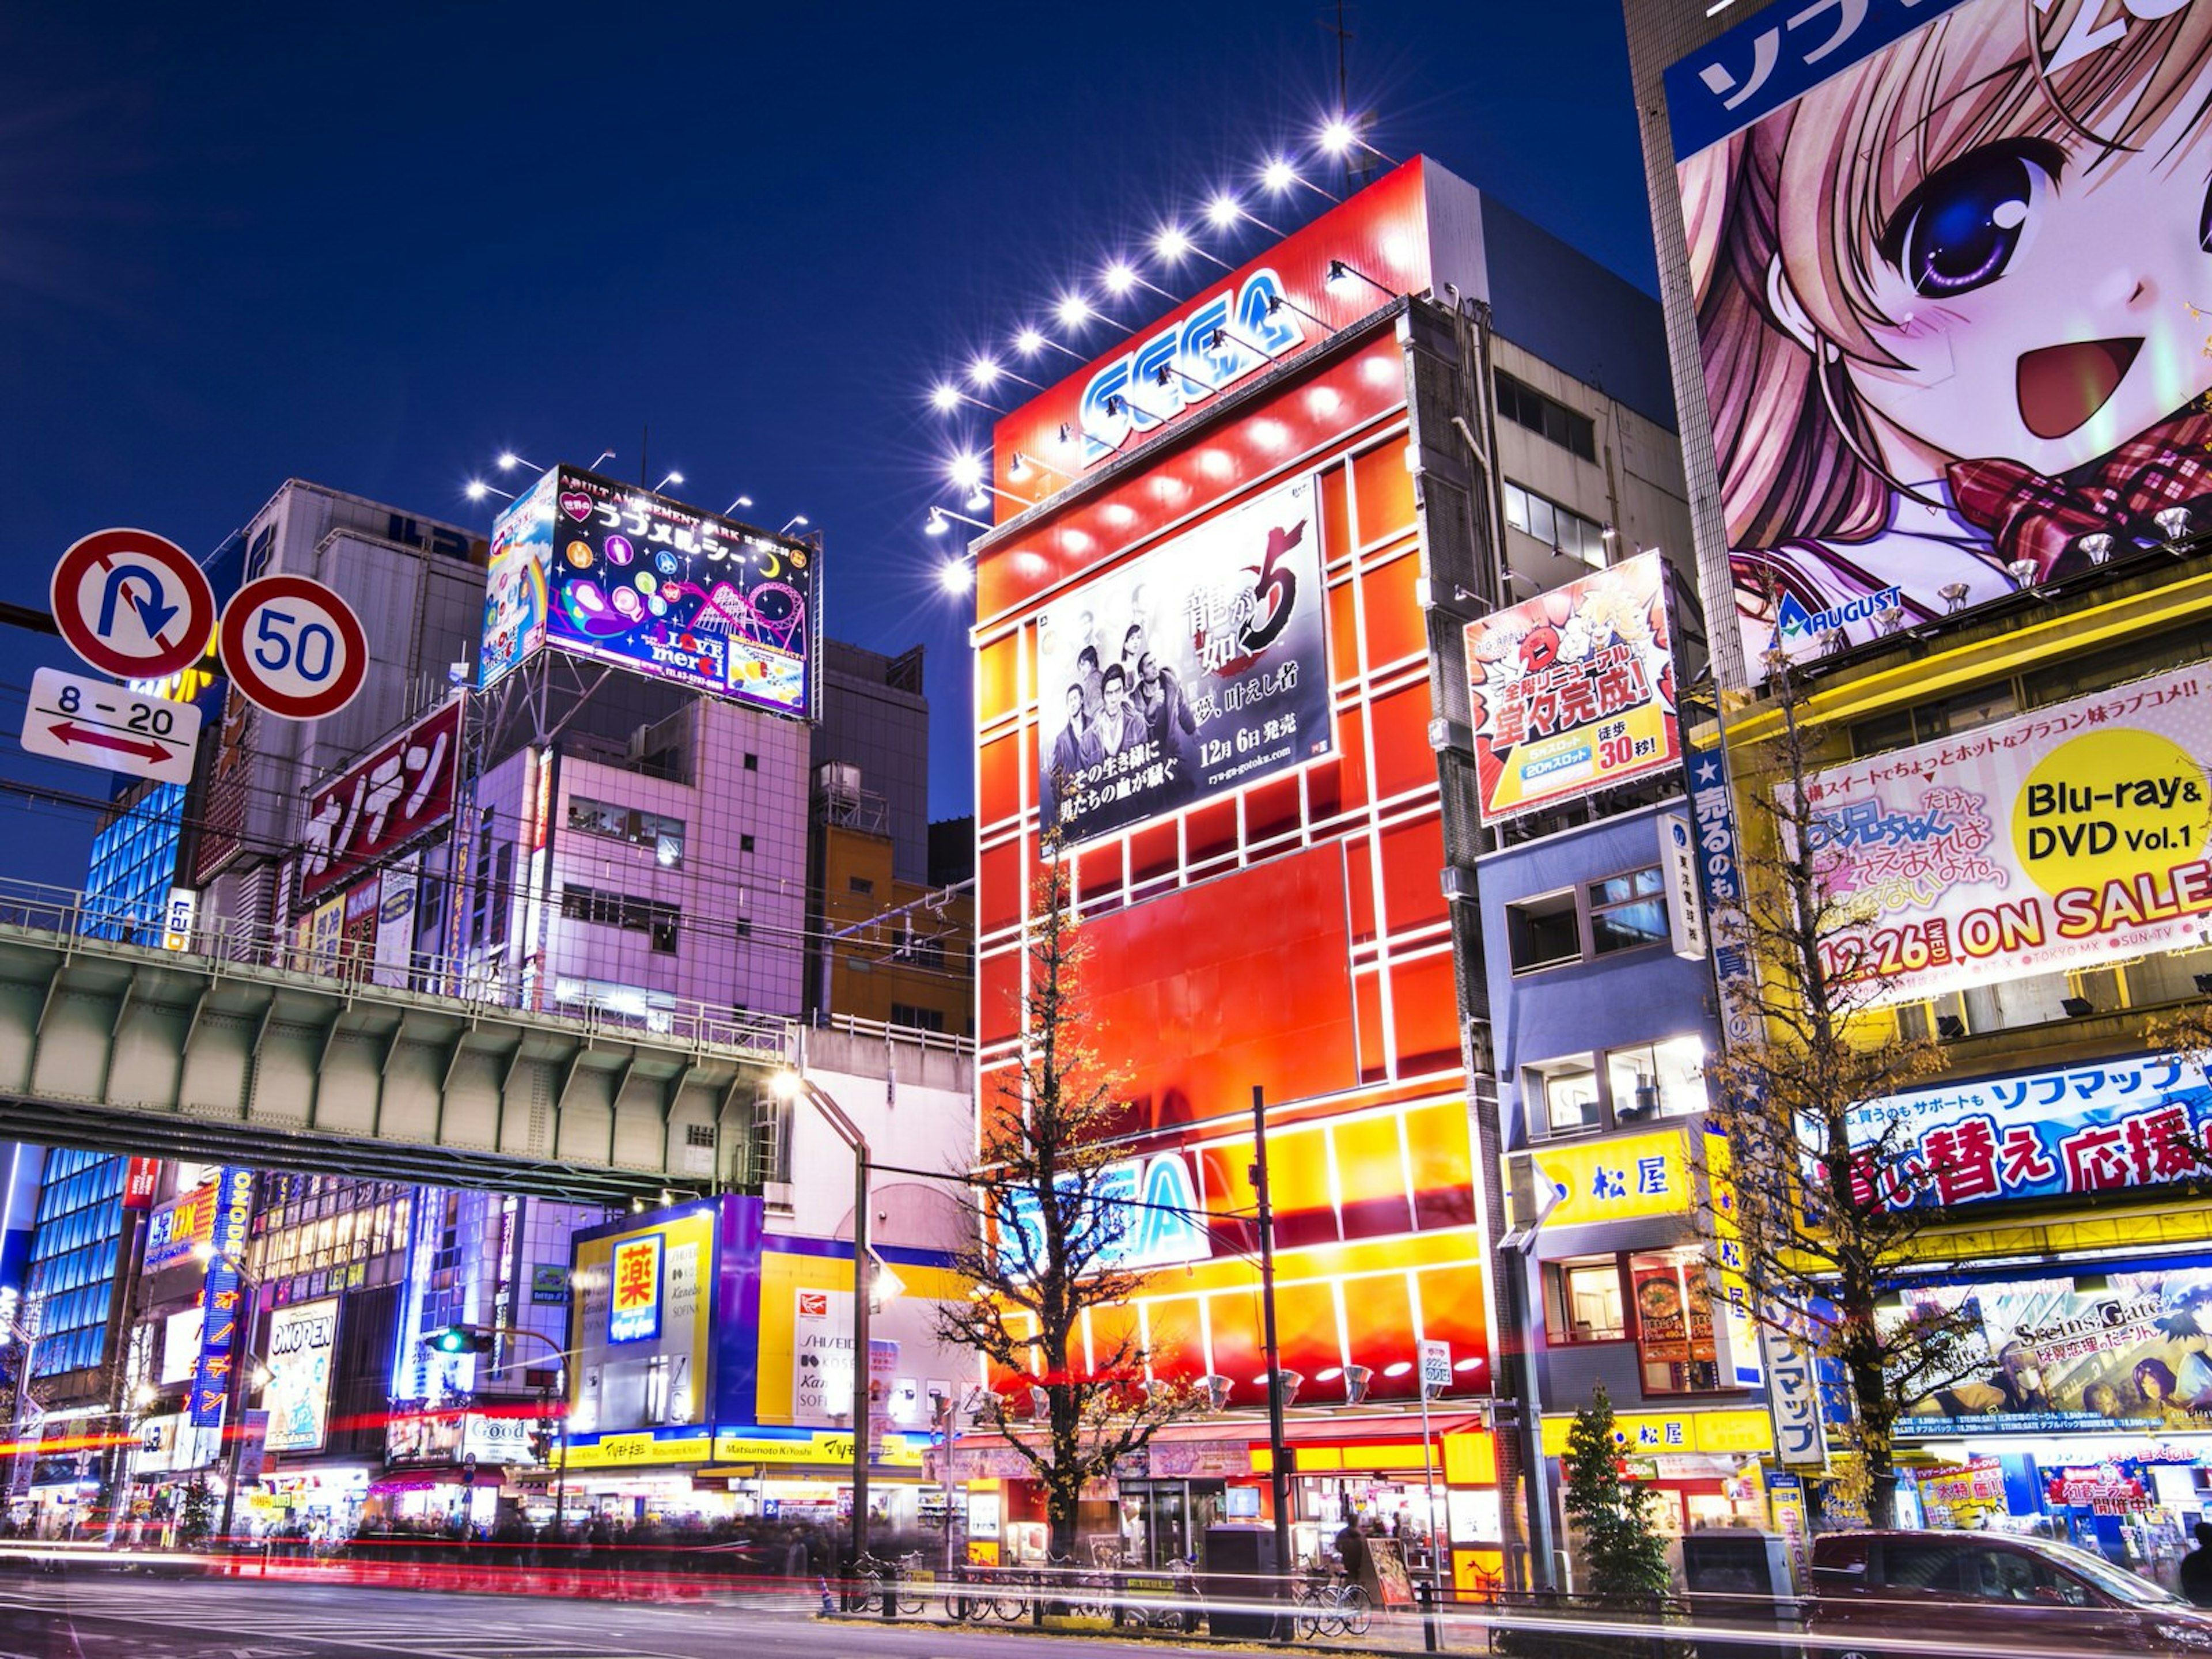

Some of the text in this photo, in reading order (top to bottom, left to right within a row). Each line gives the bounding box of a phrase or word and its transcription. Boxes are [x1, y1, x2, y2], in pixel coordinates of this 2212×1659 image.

[1699, 0, 1931, 111] ソフ
[1080, 267, 1305, 469] SEGA
[560, 474, 740, 542] ADULT AMSEMENT ARK
[1240, 517, 1306, 655] 5
[1811, 586, 1901, 634] AUGUST
[255, 608, 334, 682] 50
[652, 645, 724, 678] merci
[668, 631, 724, 662] LOVE
[1505, 643, 1631, 702] 全階リニューアル
[1199, 712, 1297, 768] 12月 6日 発売
[1598, 720, 1626, 743] 徒歩
[1074, 740, 1160, 790] その生き様に
[1209, 747, 1291, 786] ryu-ga-gotoku.com
[1925, 791, 1980, 816] だけど
[2029, 821, 2191, 860] DVD Vol.1
[1817, 925, 1931, 984] 12.26
[1960, 897, 2045, 959] ON
[2054, 860, 2212, 939] SALE
[2033, 946, 2076, 964] TOKYO
[2121, 926, 2174, 947] SUN-TV
[1858, 1105, 1911, 1124] 買うのも
[1914, 1095, 1984, 1115] サポートも
[1992, 1055, 2183, 1111] ソフマップ
[1592, 1156, 1669, 1200] 松屋
[620, 1244, 653, 1306] 薬
[672, 1283, 702, 1299] Kanebo
[1722, 1237, 1749, 1320] 松屋
[673, 1304, 700, 1318] SOFINA
[201, 1290, 240, 1412] オノデン
[272, 1316, 333, 1355] ONODEN
[800, 1334, 857, 1350] SHISEID
[800, 1393, 828, 1407] SOFI
[472, 1418, 526, 1441] Good
[1639, 1421, 1684, 1445] 松屋
[725, 1444, 779, 1457] Matsumoto
